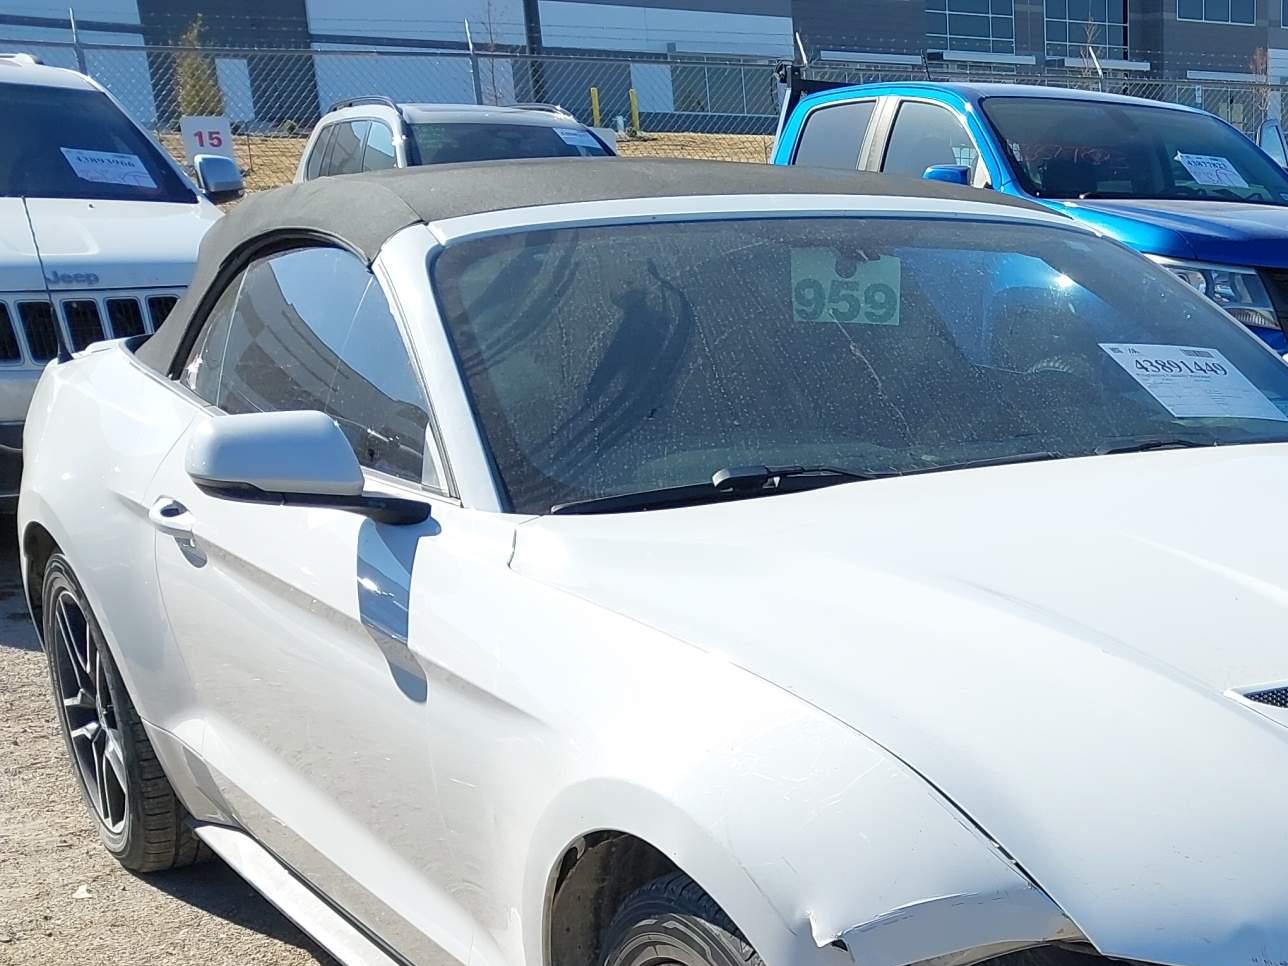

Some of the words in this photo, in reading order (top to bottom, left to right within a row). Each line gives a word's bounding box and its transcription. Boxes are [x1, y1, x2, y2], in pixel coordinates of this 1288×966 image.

[194, 131, 222, 147] 15
[47, 270, 99, 285] Jeep
[794, 278, 898, 323] 959
[1135, 358, 1228, 376] 43891449
